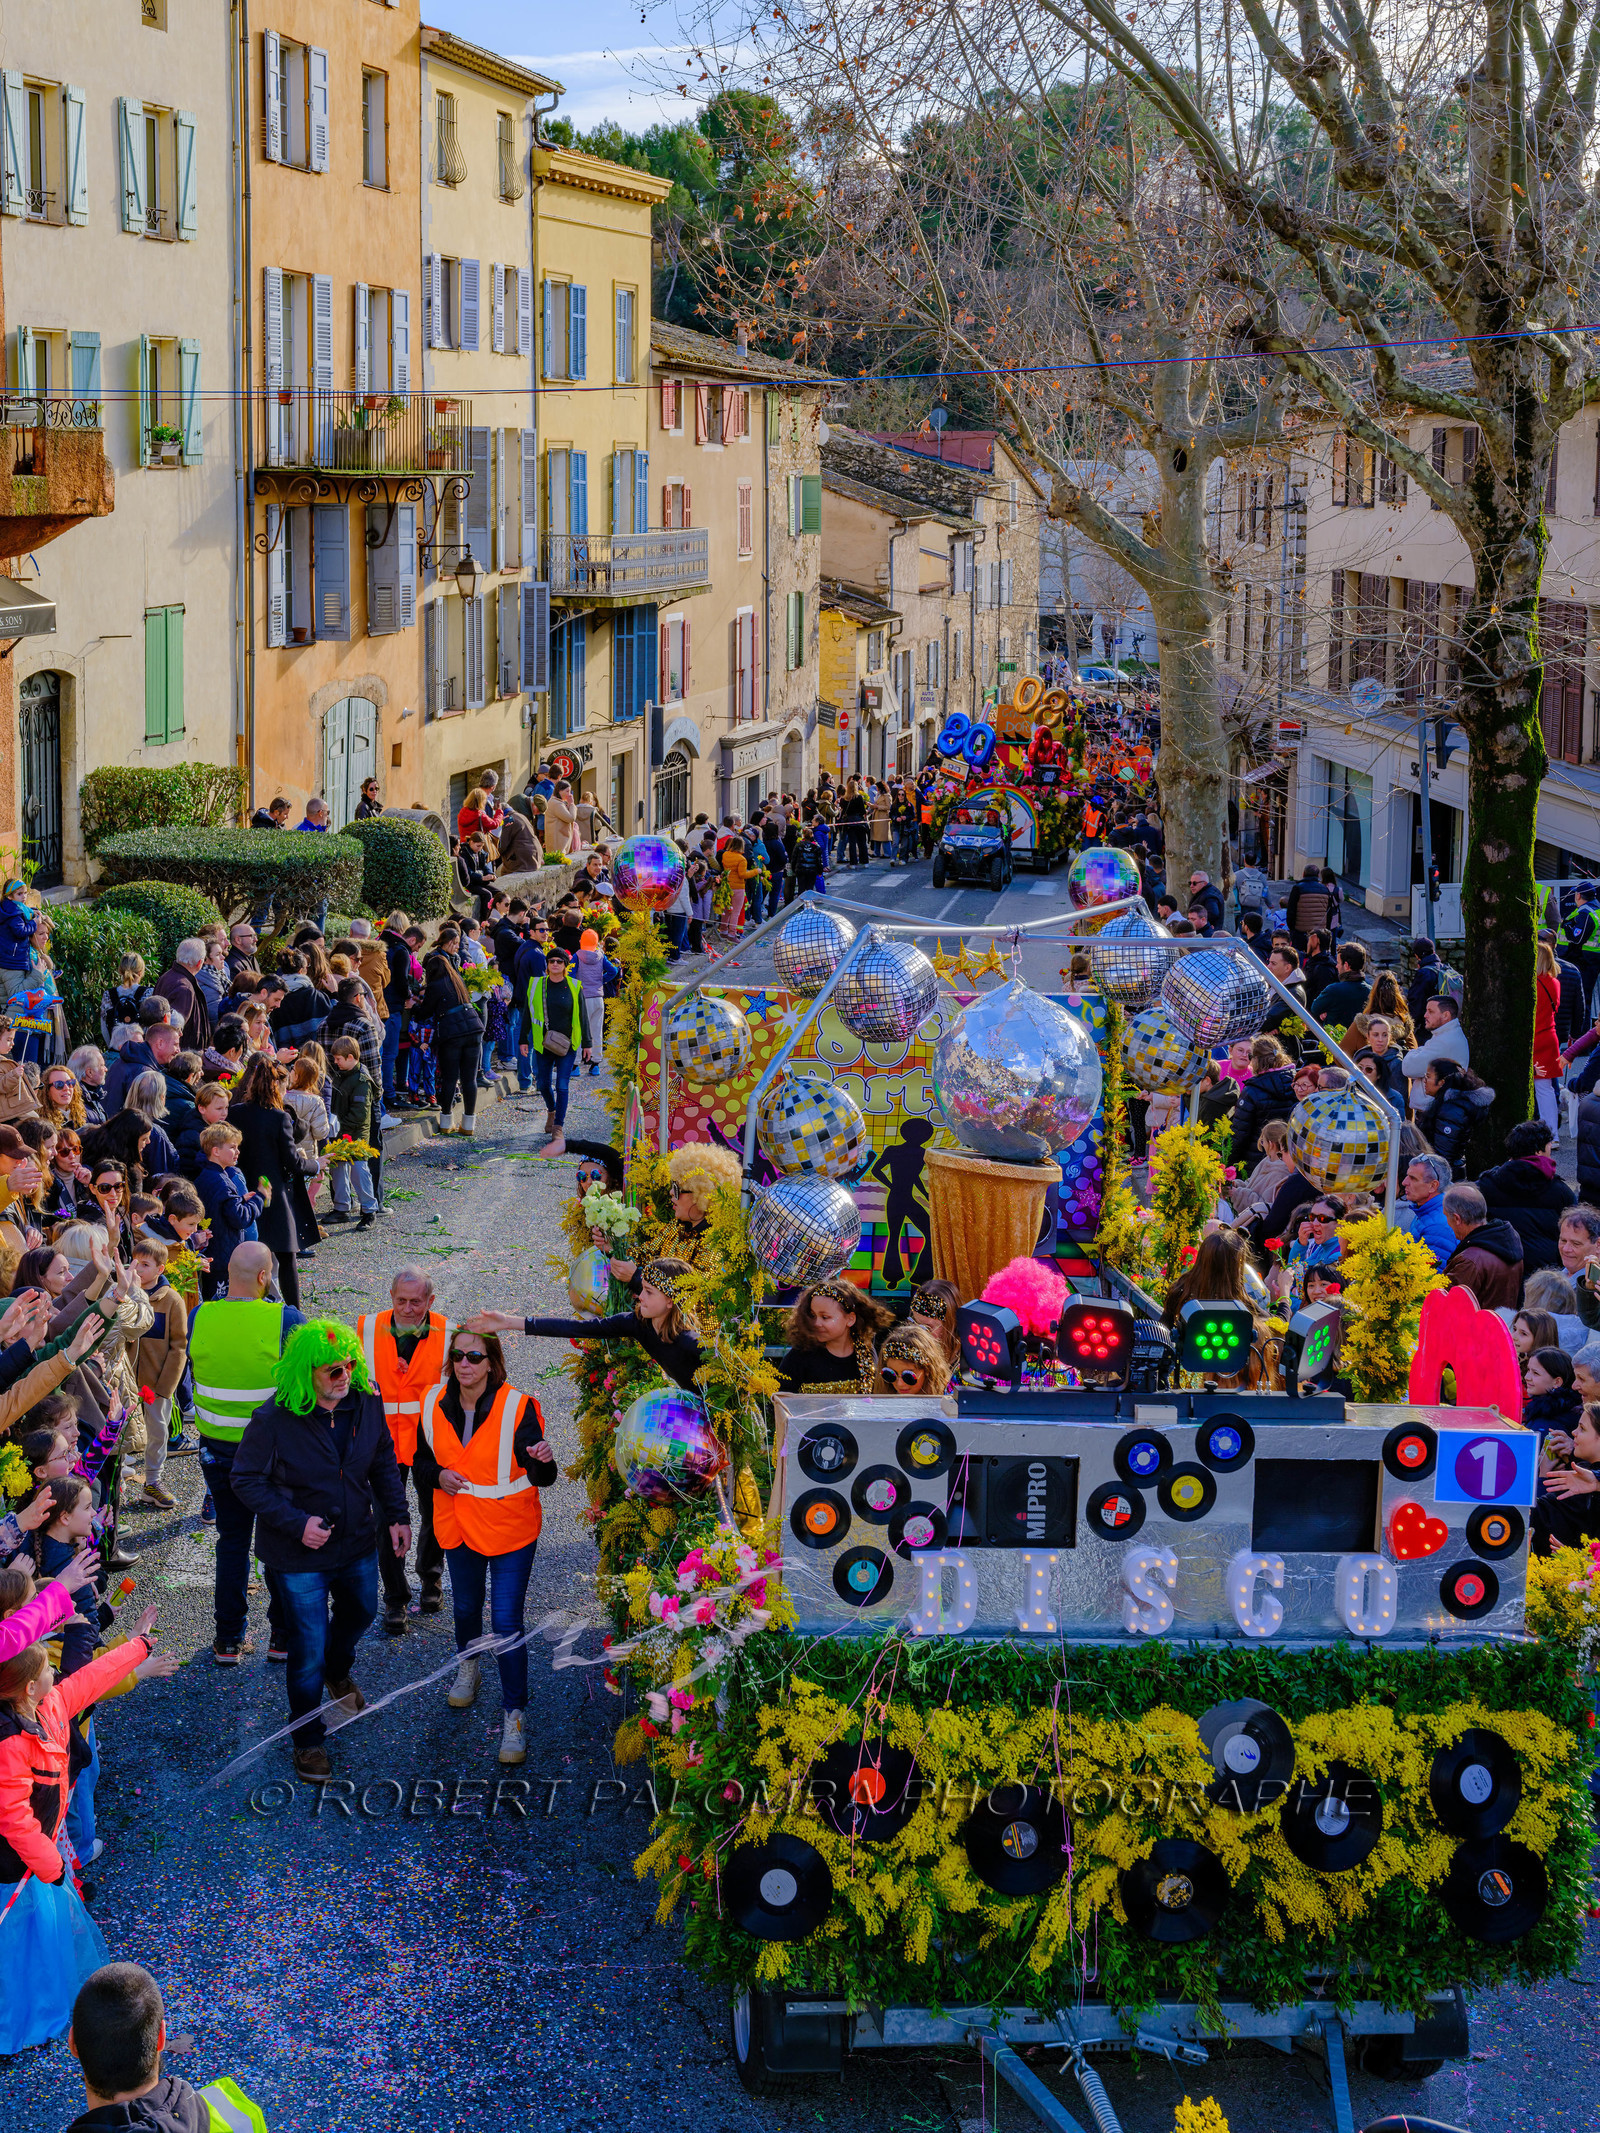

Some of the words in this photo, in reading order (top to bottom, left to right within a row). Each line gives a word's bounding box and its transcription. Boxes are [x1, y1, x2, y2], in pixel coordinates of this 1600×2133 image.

[5, 615, 22, 626] SONS
[1026, 1462, 1047, 1540] MIPRO
[1469, 1441, 1499, 1497] 1
[908, 1549, 1398, 1637] DISCO
